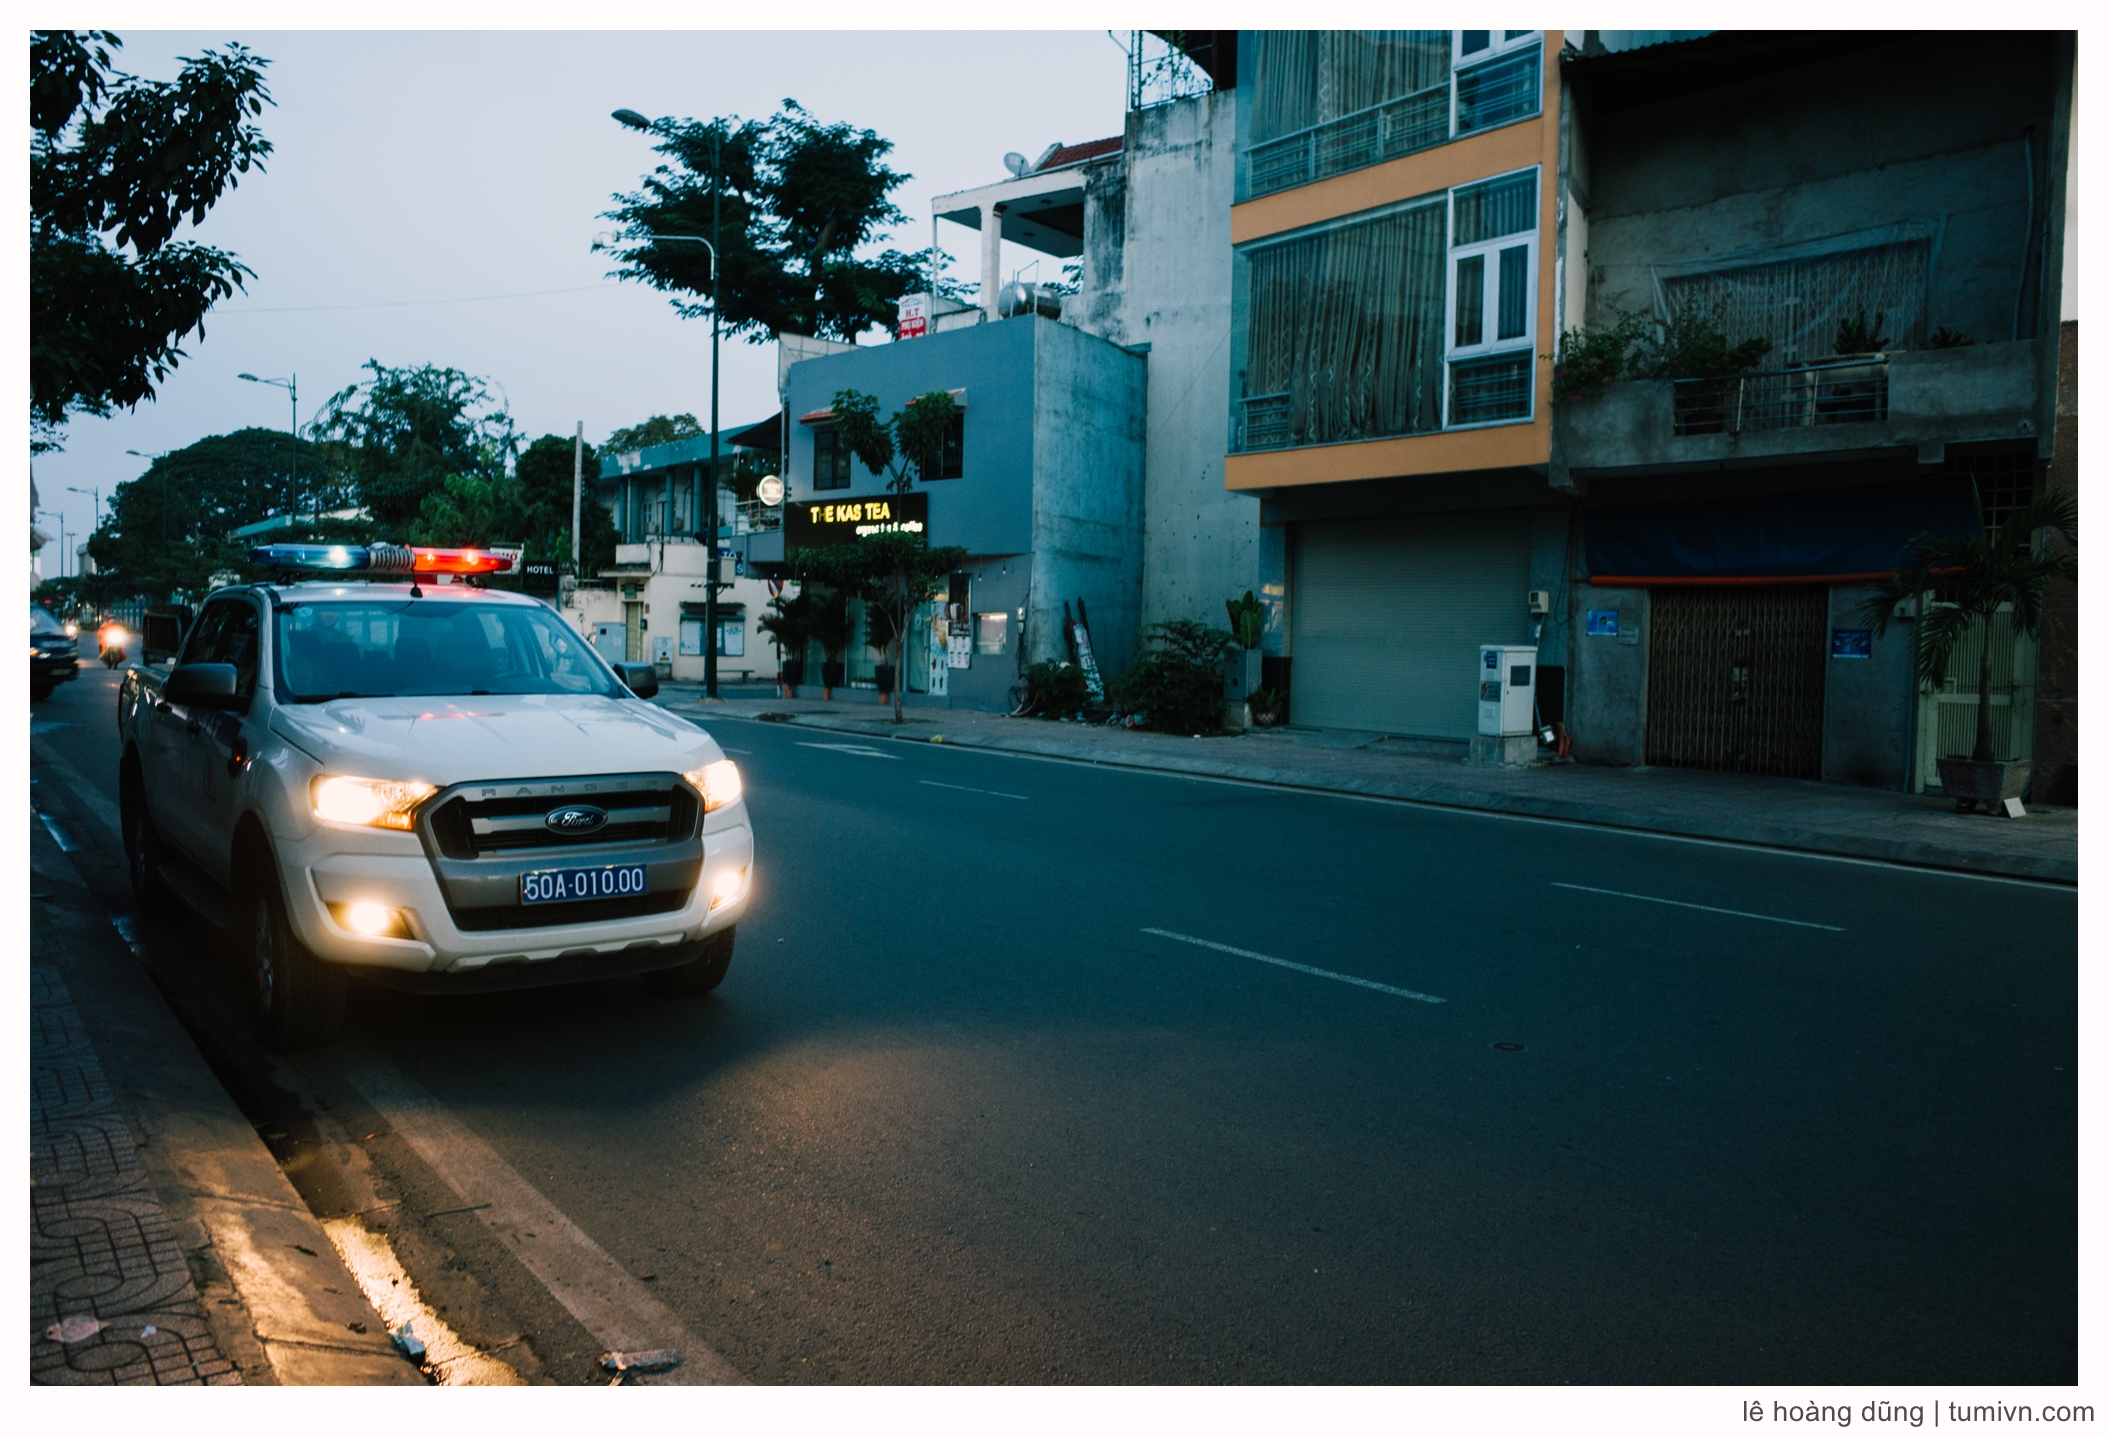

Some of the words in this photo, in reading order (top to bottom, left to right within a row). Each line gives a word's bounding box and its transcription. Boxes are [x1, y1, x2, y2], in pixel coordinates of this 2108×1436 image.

[810, 506, 834, 523] THE
[836, 504, 862, 522] KAS
[864, 502, 890, 520] TEA
[526, 565, 555, 575] HOTEL
[481, 780, 660, 797] RANGER
[561, 810, 595, 828] Ford
[526, 867, 644, 900] 50A-010.00
